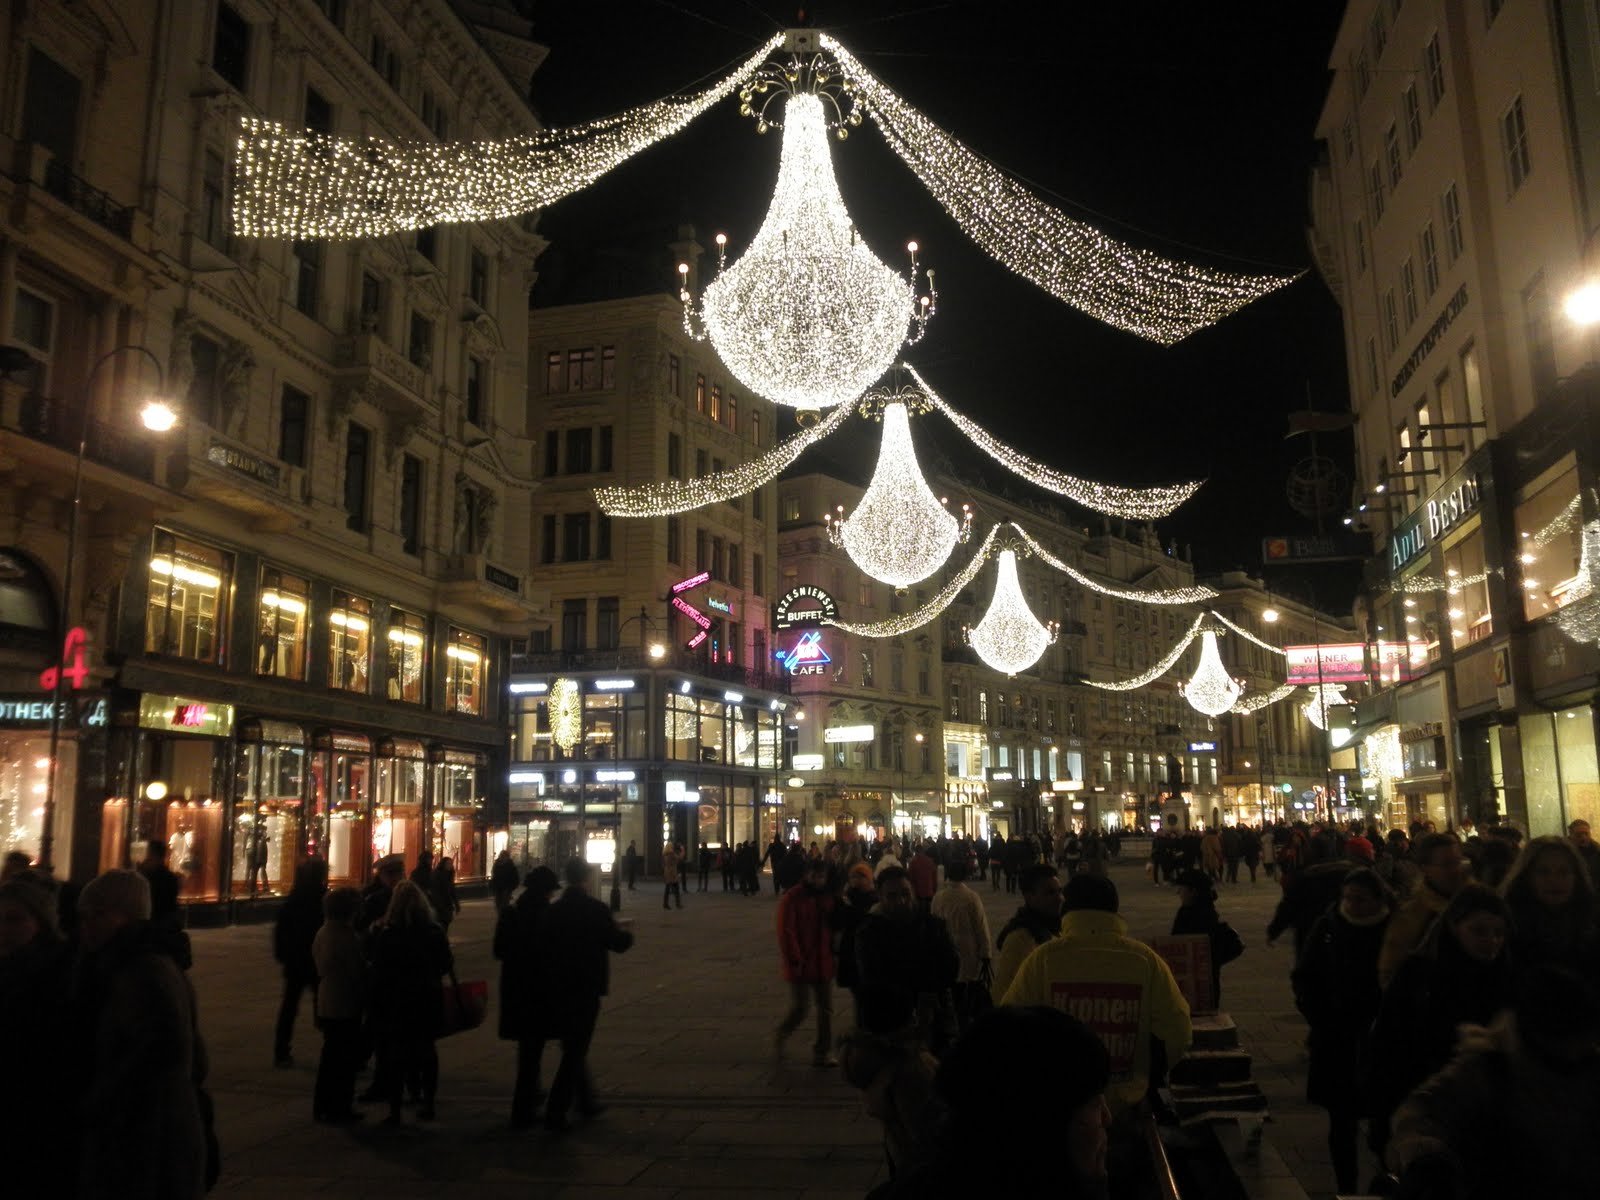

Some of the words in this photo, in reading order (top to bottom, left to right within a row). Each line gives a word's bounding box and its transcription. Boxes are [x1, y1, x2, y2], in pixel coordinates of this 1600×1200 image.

[1427, 473, 1480, 540] BESIM
[672, 598, 711, 630] FLEDERMAUS
[787, 610, 823, 621] BUFFET
[1303, 654, 1348, 664] WIENER
[790, 665, 824, 676] CAFE
